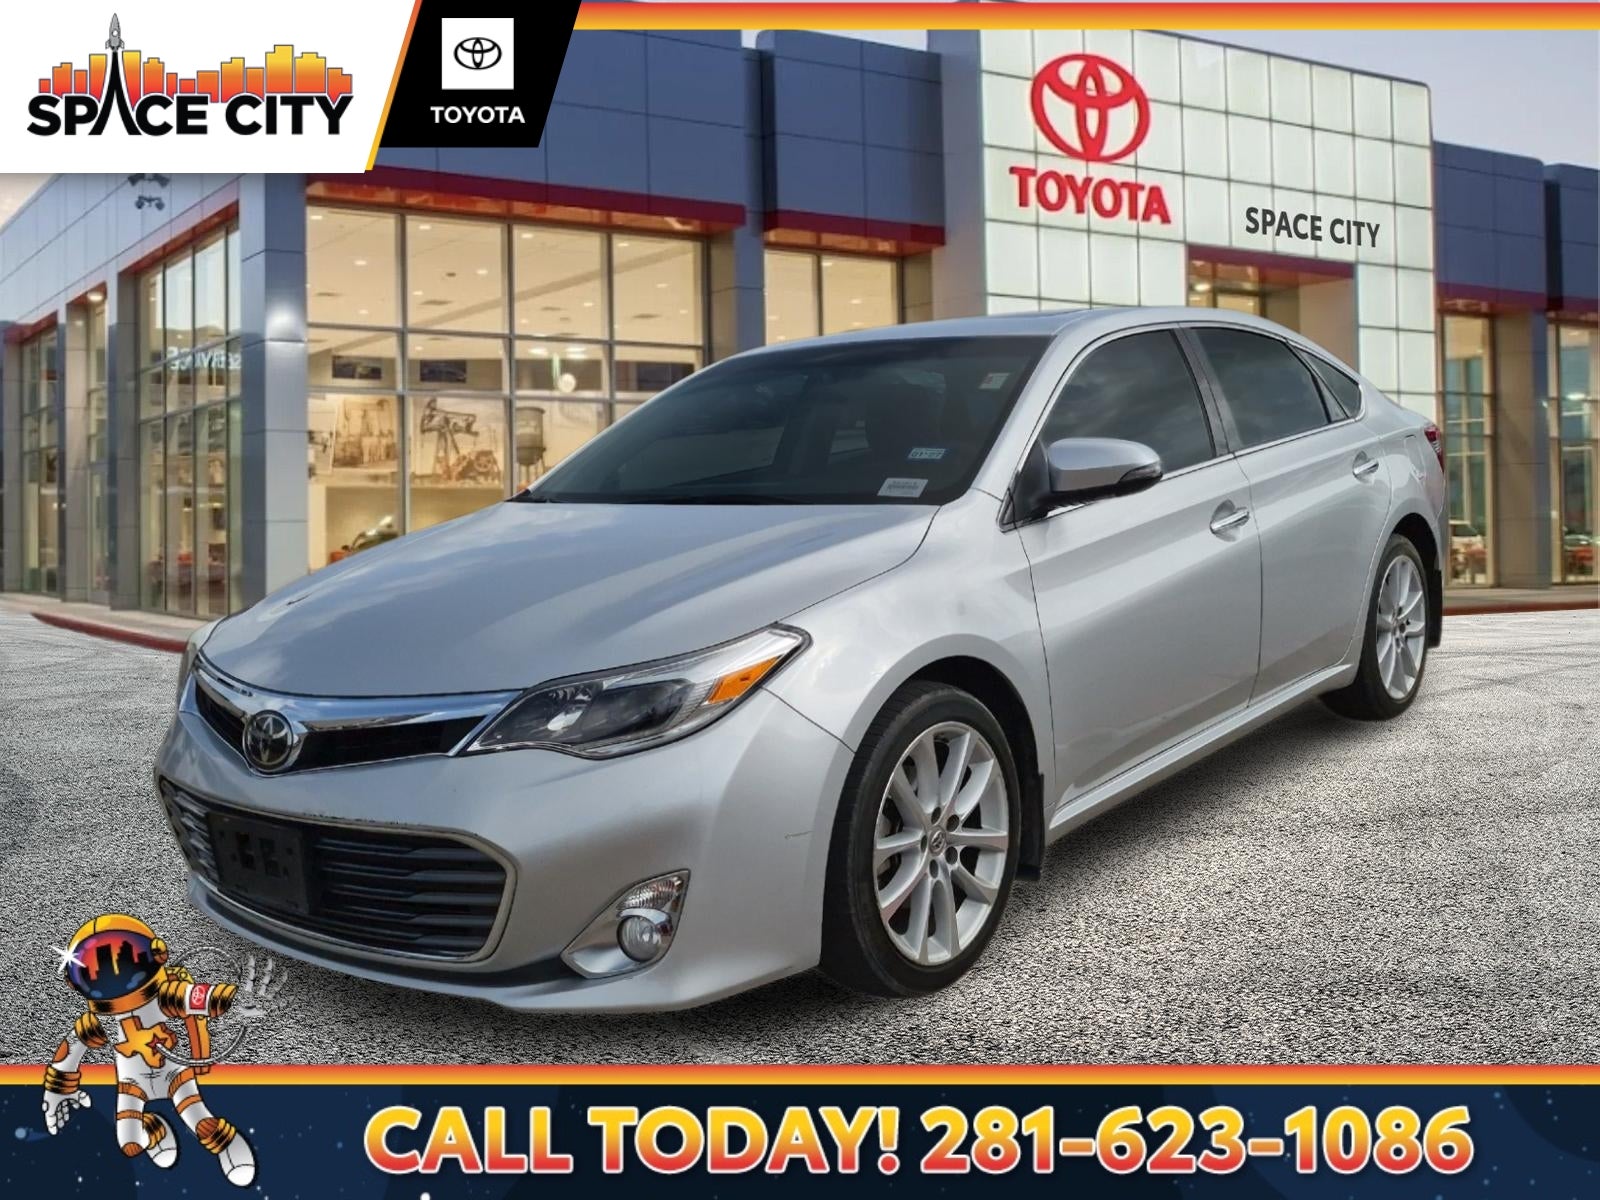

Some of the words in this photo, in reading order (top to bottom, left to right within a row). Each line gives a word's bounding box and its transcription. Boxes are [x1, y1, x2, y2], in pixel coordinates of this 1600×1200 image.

[1009, 165, 1171, 225] TOYOTA
[1245, 206, 1323, 242] SPACE
[1329, 218, 1381, 248] CITY
